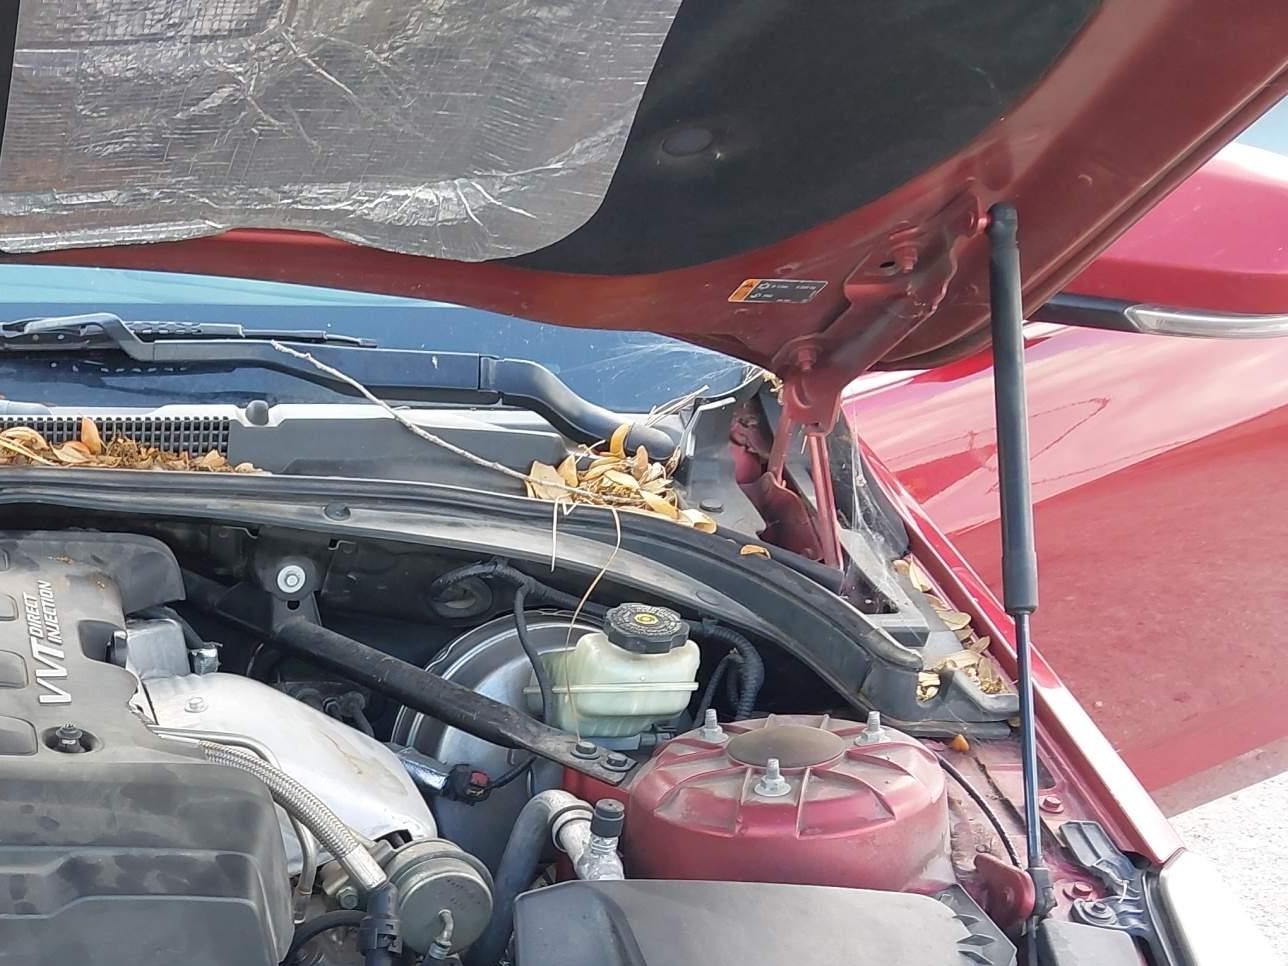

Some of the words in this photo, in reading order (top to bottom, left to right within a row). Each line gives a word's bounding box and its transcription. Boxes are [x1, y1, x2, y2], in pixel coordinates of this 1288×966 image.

[23, 591, 43, 639] DIRECT
[38, 580, 63, 645] INJECTION
[30, 636, 72, 704] VVT
